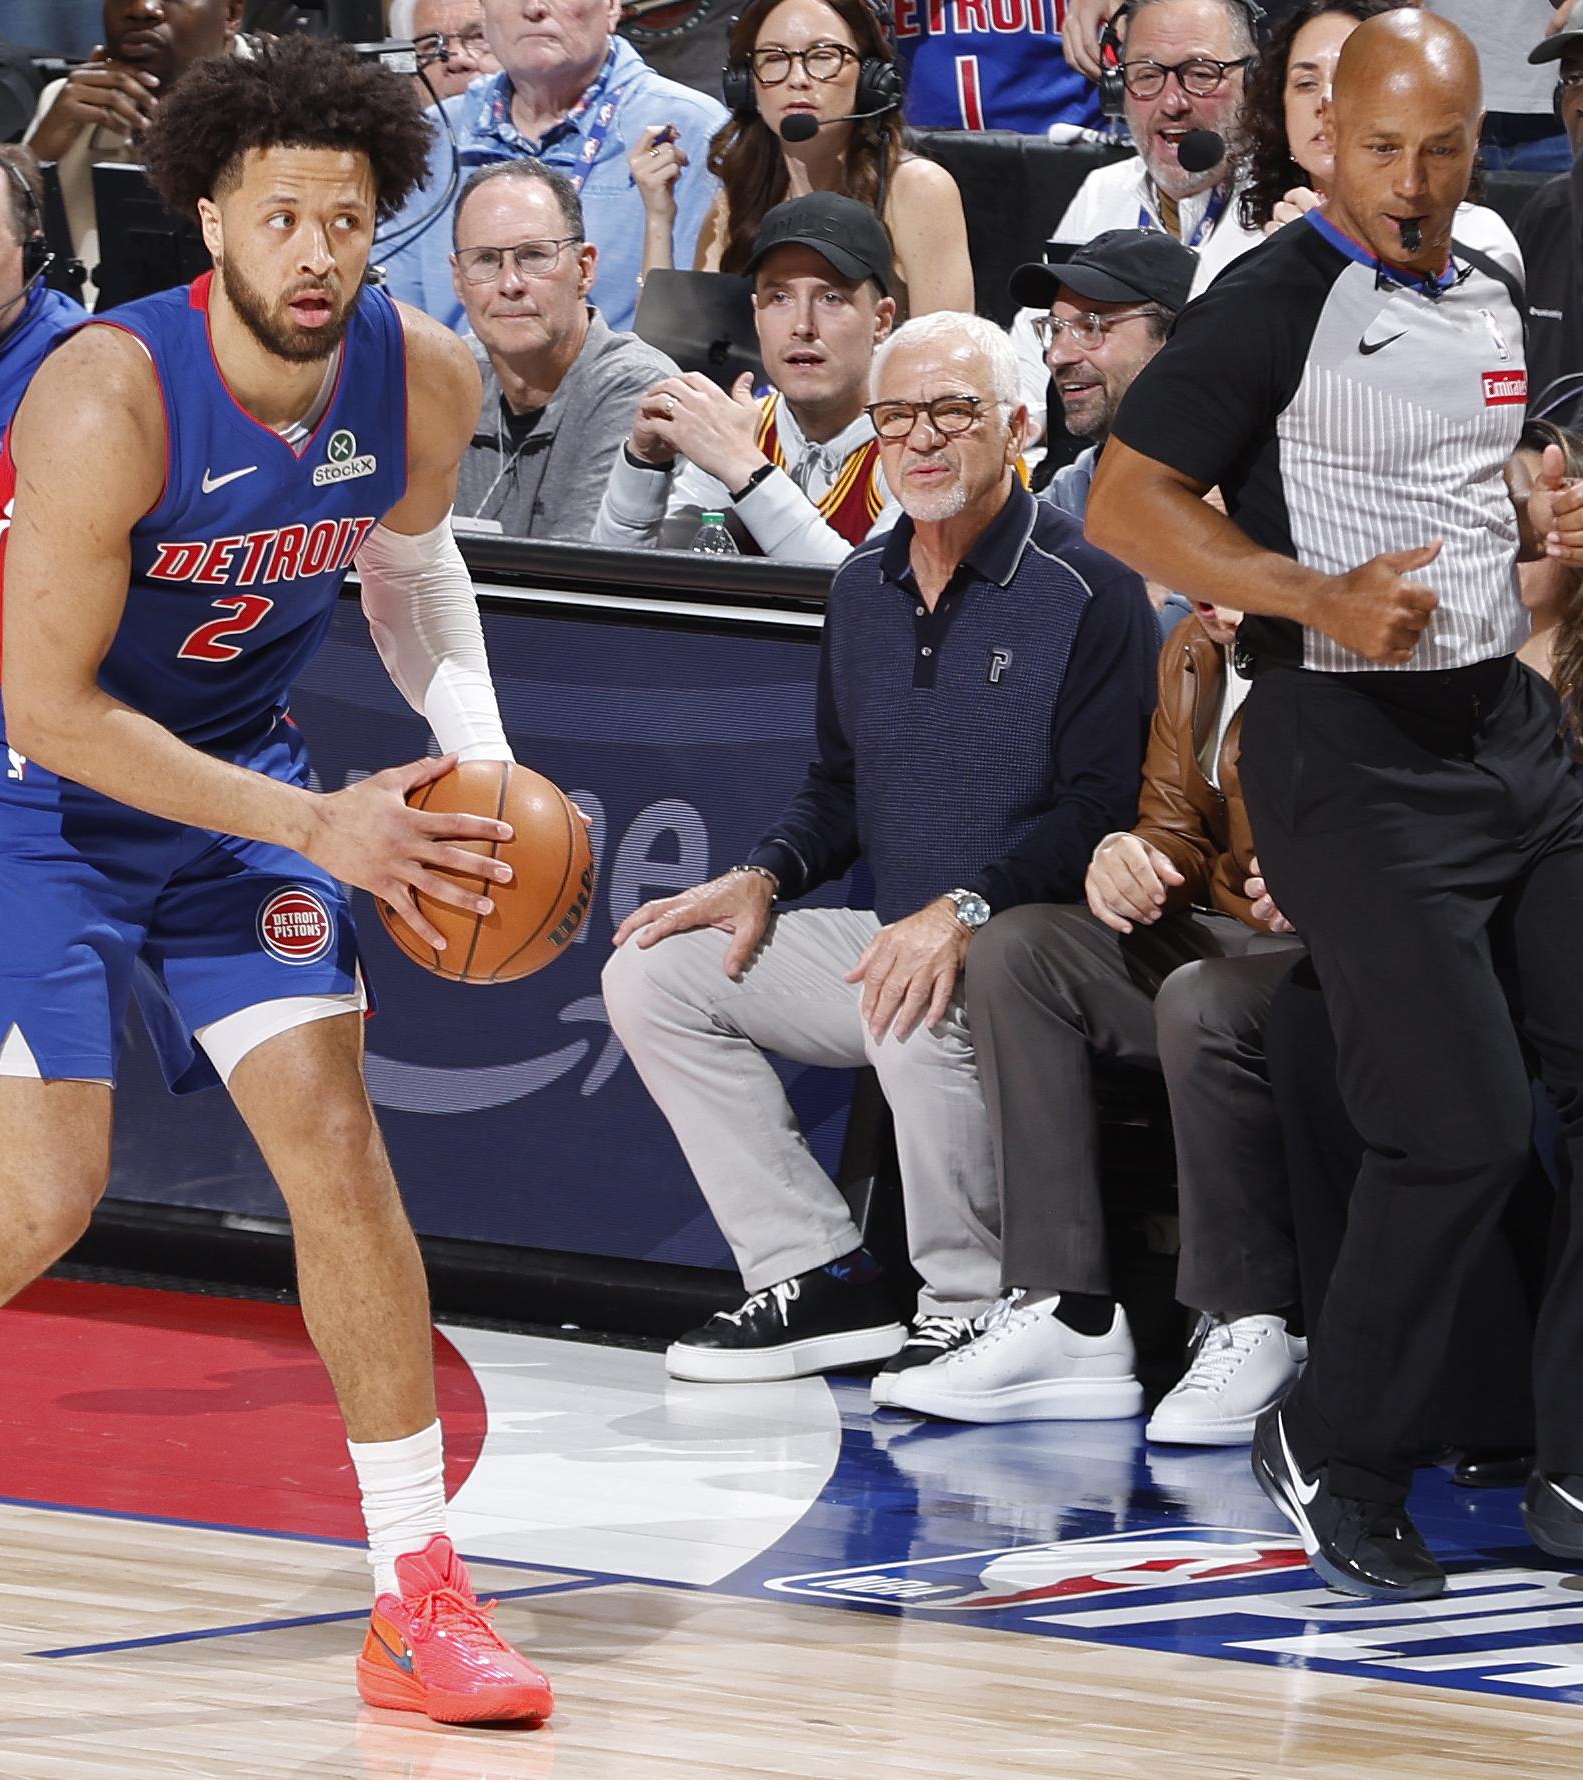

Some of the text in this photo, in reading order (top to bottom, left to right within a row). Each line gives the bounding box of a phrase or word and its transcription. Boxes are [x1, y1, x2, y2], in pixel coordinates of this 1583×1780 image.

[955, 54, 985, 131] 1
[146, 516, 375, 587] DETROIT
[176, 593, 274, 663] 2
[272, 911, 319, 926] DETROIT
[273, 924, 321, 939] PISTONS
[807, 1575, 964, 1598] NBA
